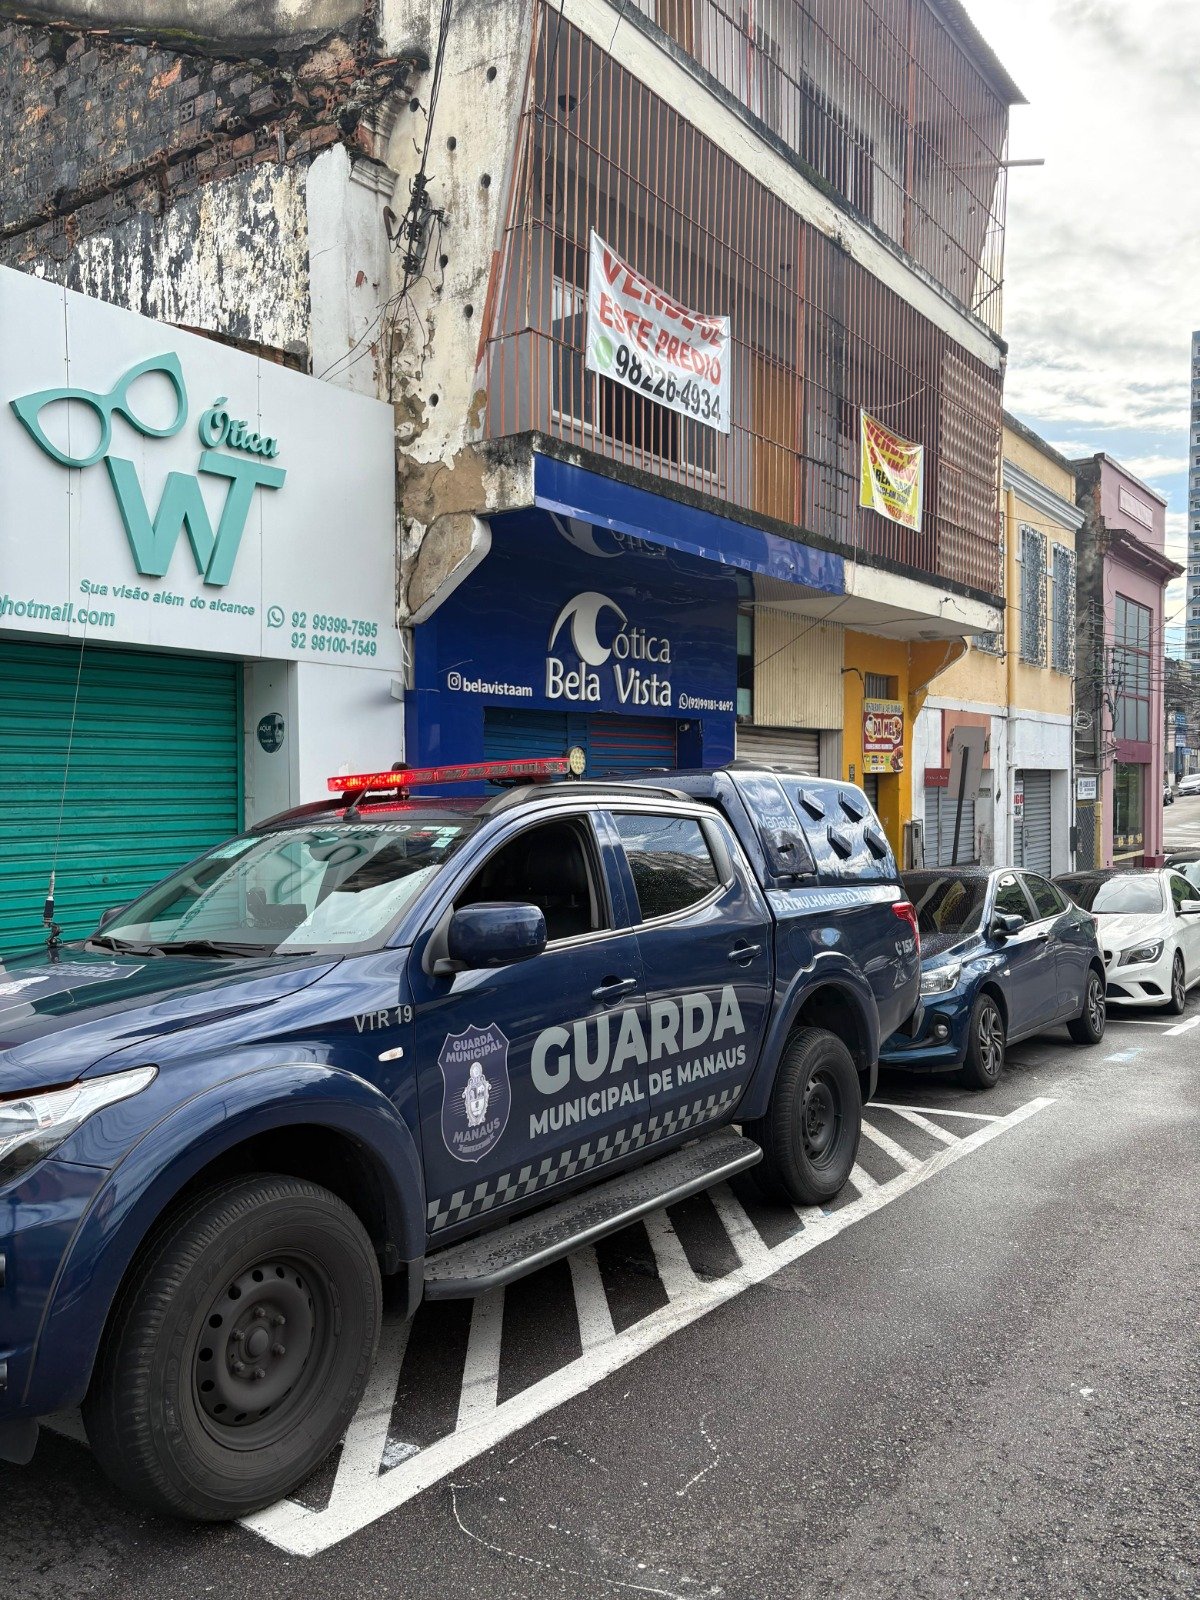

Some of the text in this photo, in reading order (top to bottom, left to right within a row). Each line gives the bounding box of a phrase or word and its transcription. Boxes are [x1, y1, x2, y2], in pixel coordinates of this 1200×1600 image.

[600, 291, 722, 385] ESTE PRÉDIO
[615, 344, 721, 424] 98226-4934
[199, 396, 280, 459] Ótica
[80, 579, 256, 616] Sua visão além do alcance
[291, 611, 379, 638] 92 99399-7595
[290, 632, 378, 656] 92 98100-1549
[612, 621, 672, 664] ótica
[462, 679, 533, 697] belavistaam
[545, 657, 673, 708] Bela Vista
[755, 813, 797, 829] Manaus
[776, 891, 854, 912] PATRULHAMENTO
[353, 1004, 413, 1034] VTR 19
[445, 1039, 503, 1062] MUNICIPAL
[453, 1032, 494, 1051] GUARDA
[531, 984, 746, 1095] GUARDA
[529, 1045, 747, 1140] MUNICIPAL DE MANAUS
[453, 1117, 501, 1144] MANAUS
